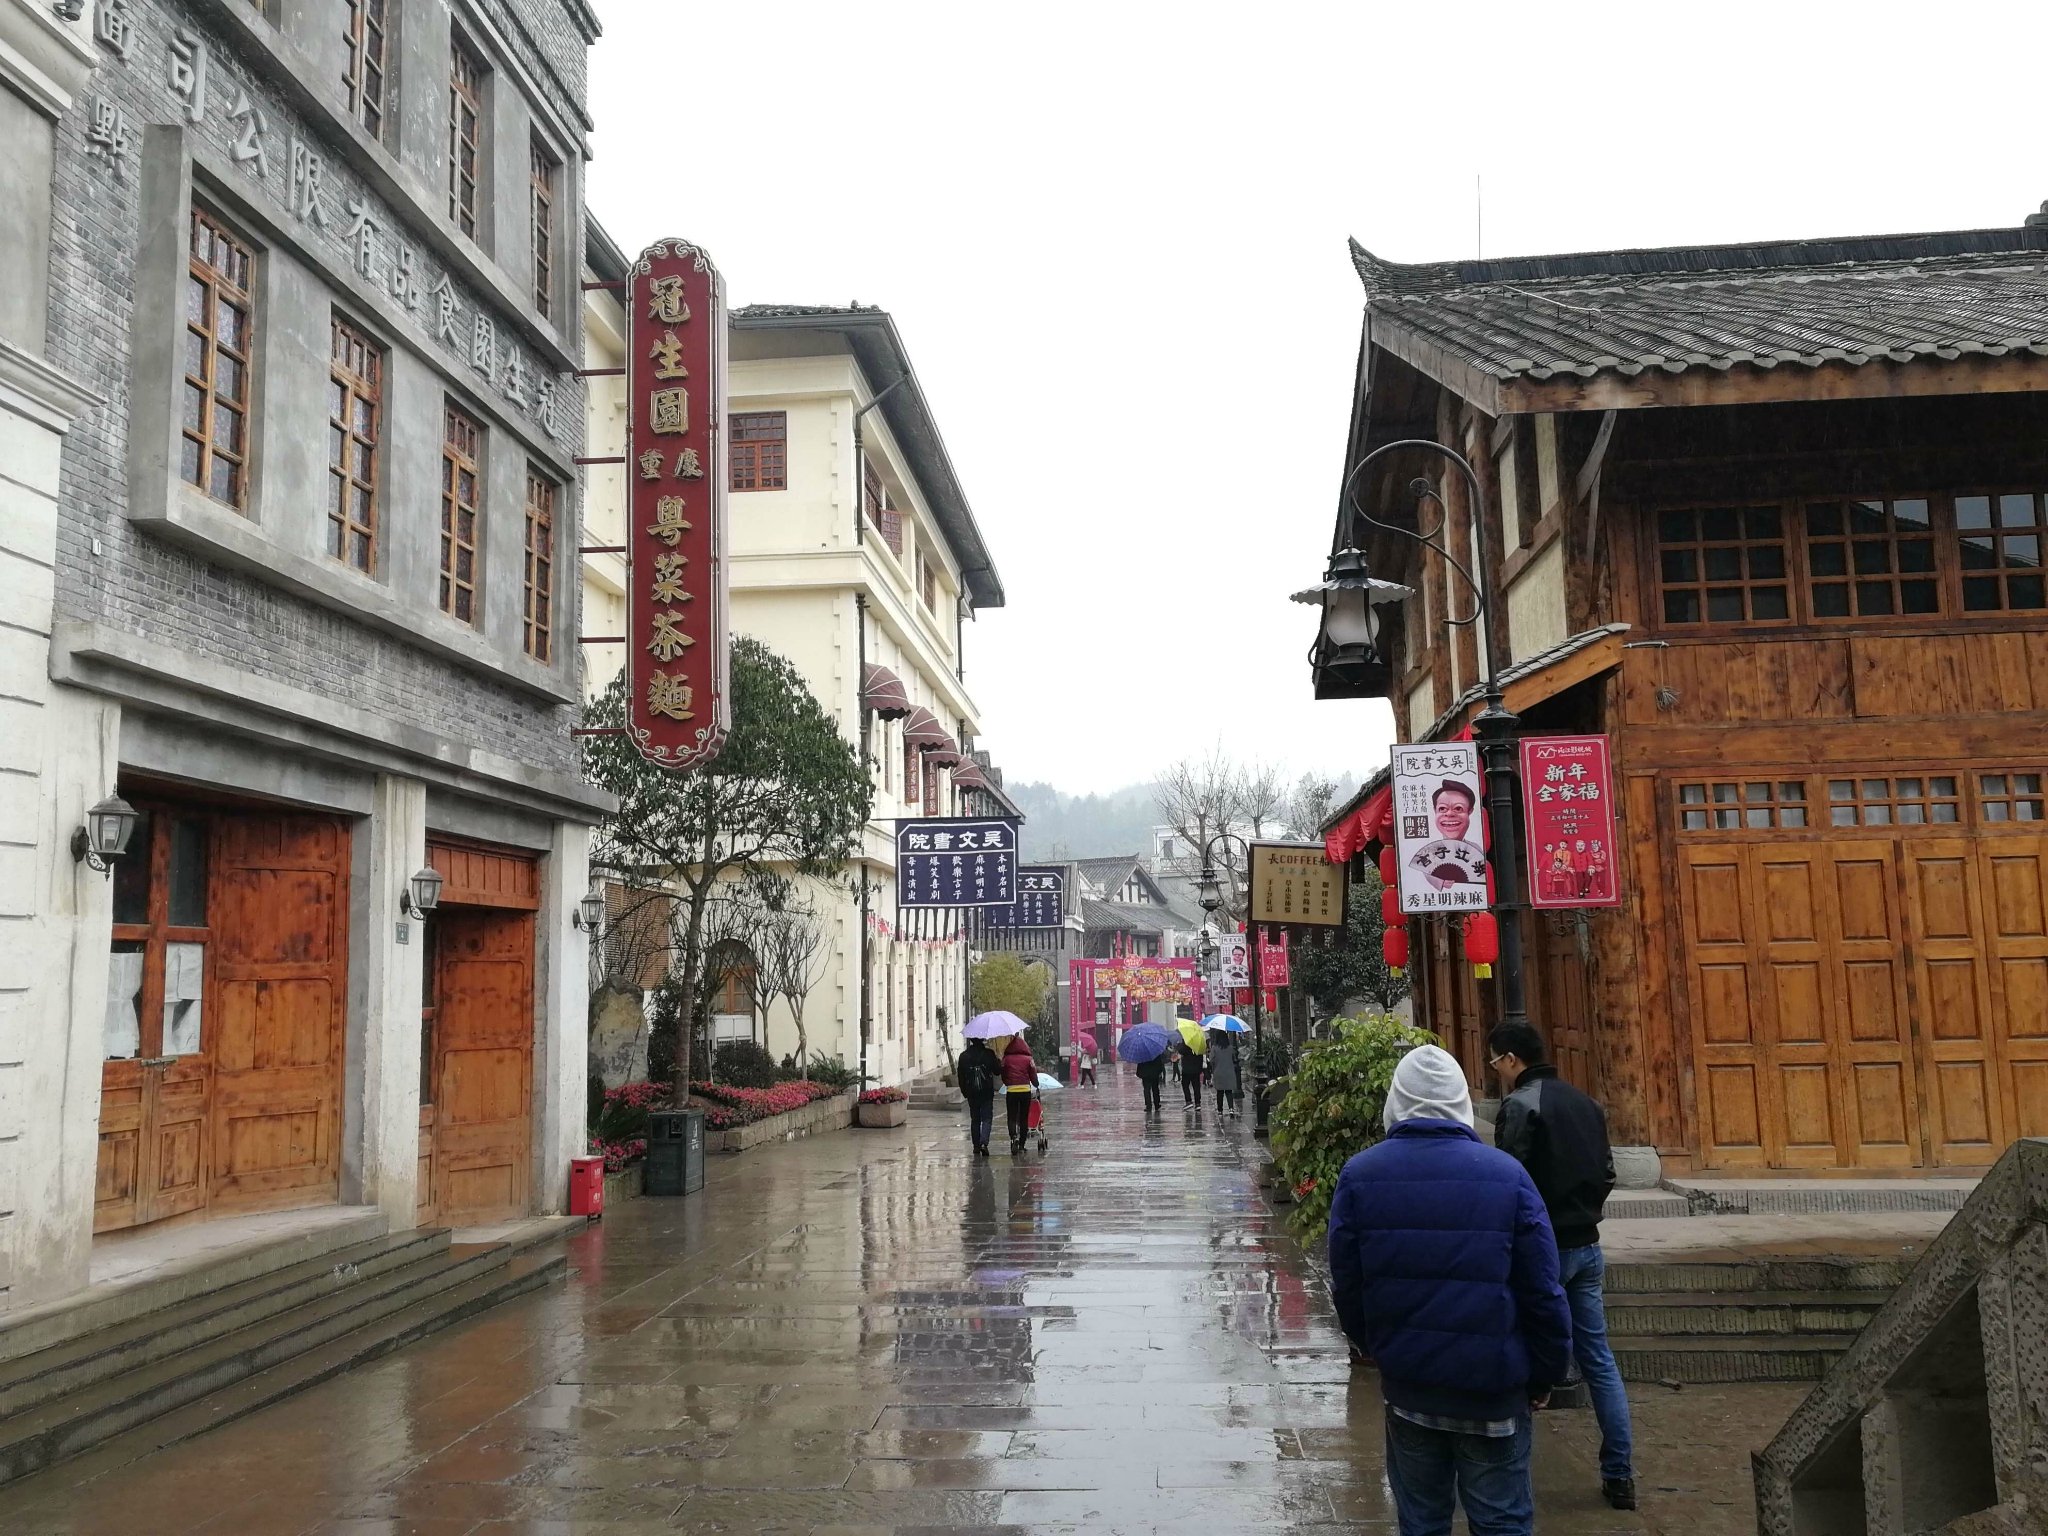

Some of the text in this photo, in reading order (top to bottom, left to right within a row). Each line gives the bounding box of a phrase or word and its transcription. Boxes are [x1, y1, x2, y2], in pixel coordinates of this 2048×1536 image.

[1545, 762, 1587, 782] 新年
[1536, 782, 1600, 802] 全家福
[907, 856, 916, 901] 每日演出
